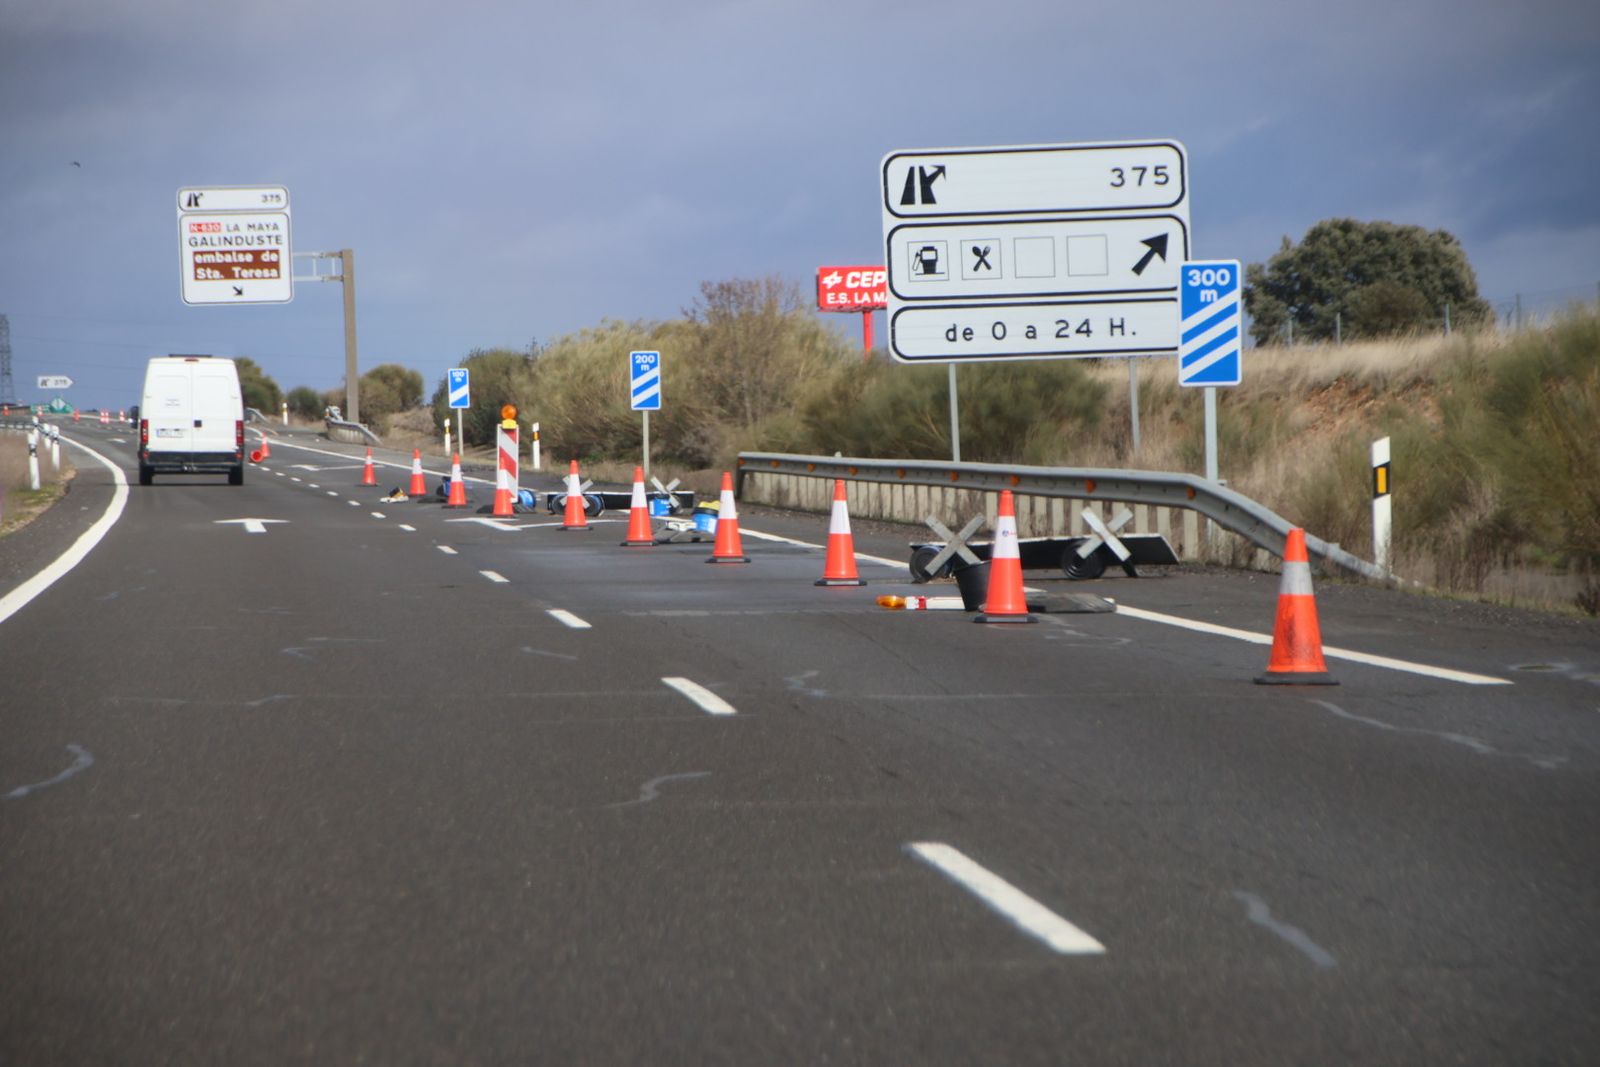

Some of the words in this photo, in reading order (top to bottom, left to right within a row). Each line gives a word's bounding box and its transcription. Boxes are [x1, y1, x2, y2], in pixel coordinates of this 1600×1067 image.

[1110, 165, 1169, 187] 375
[261, 194, 282, 203] 375
[226, 223, 241, 232] LA
[247, 222, 280, 232] MAYA
[188, 234, 283, 247] GALINDUSTE
[261, 249, 279, 262] de
[196, 266, 225, 279] Sta.
[231, 265, 279, 279] Teresa
[1188, 269, 1230, 287] 300
[827, 292, 851, 304] E.S.
[854, 292, 871, 303] LA
[1200, 288, 1218, 303] m
[945, 323, 974, 342] de
[1025, 325, 1038, 340] a
[1055, 318, 1093, 339] 24
[1110, 317, 1137, 337] H.
[635, 355, 655, 364] 200
